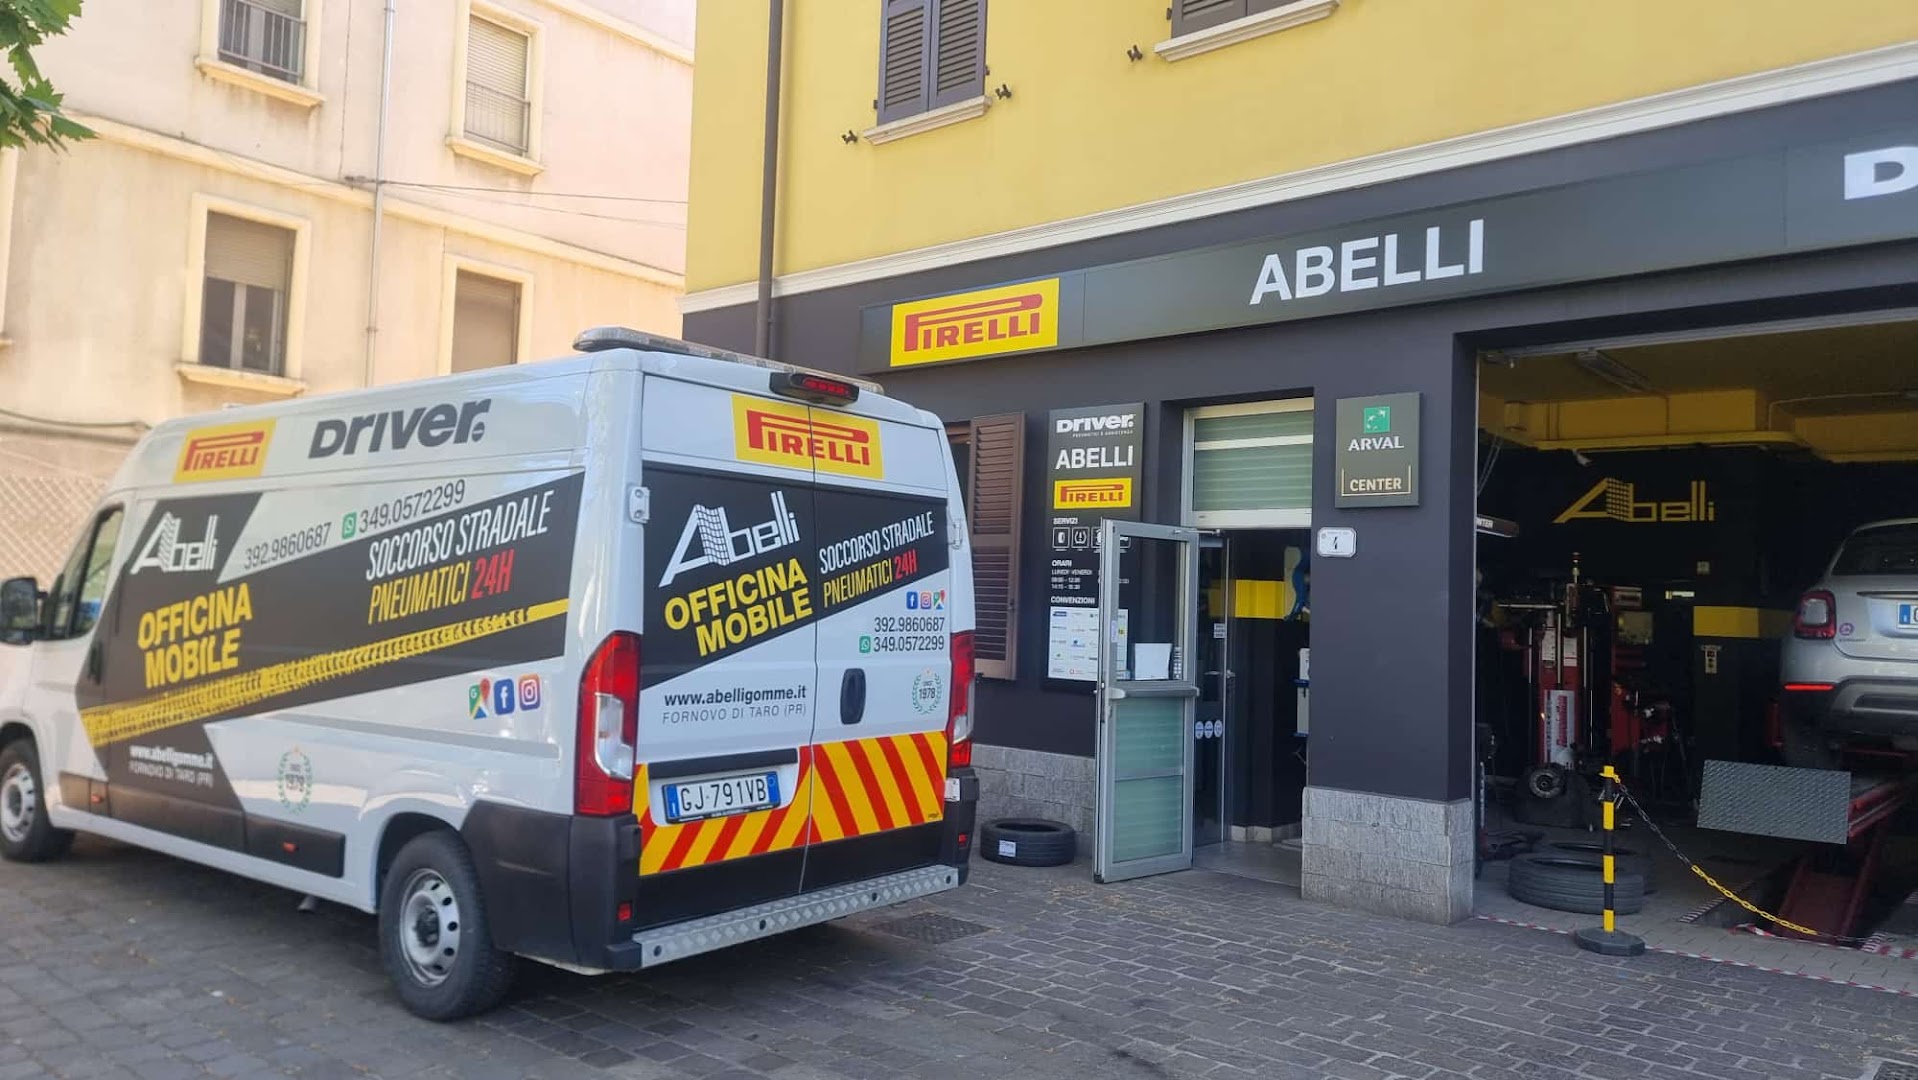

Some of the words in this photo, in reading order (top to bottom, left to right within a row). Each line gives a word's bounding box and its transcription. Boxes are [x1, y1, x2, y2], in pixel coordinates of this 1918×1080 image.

[1249, 219, 1484, 306] ABELLI
[904, 293, 1043, 352] PIRELLI
[183, 431, 265, 472] PIRELLI
[747, 410, 870, 466] PIRELLI
[1055, 445, 1133, 469] ABELLI
[1348, 436, 1404, 451] ARVAL
[359, 479, 466, 534] 349.0572299
[1060, 484, 1124, 502] PIRELLI
[1350, 477, 1402, 492] CENTER
[1552, 477, 1715, 524] Abelli
[130, 511, 218, 575] Abelli
[244, 522, 332, 570] 392.9860687
[366, 519, 455, 580] SOCCORSO
[456, 490, 554, 555] STRADALE
[659, 491, 800, 588] Abelli
[820, 530, 880, 574] SOCCORSO
[881, 511, 935, 551] STRADALE
[368, 561, 471, 625] PNEUMATICI
[471, 549, 515, 599] 24H
[664, 558, 807, 630] OFFICINA
[823, 558, 893, 608] PNEUMATICI
[894, 549, 917, 580] 24H
[138, 583, 252, 649] OFFICINA
[696, 587, 813, 656] MOBILE
[874, 617, 945, 633] 392.9860687
[145, 628, 241, 689] MOBILE
[874, 636, 945, 652] 349.0572299
[662, 708, 727, 725] FORNOVO
[731, 707, 745, 720] DI
[750, 704, 779, 718] TARO
[784, 702, 807, 718] (PR)
[664, 685, 806, 706] www.abelligomme.it
[919, 687, 936, 699] 1978
